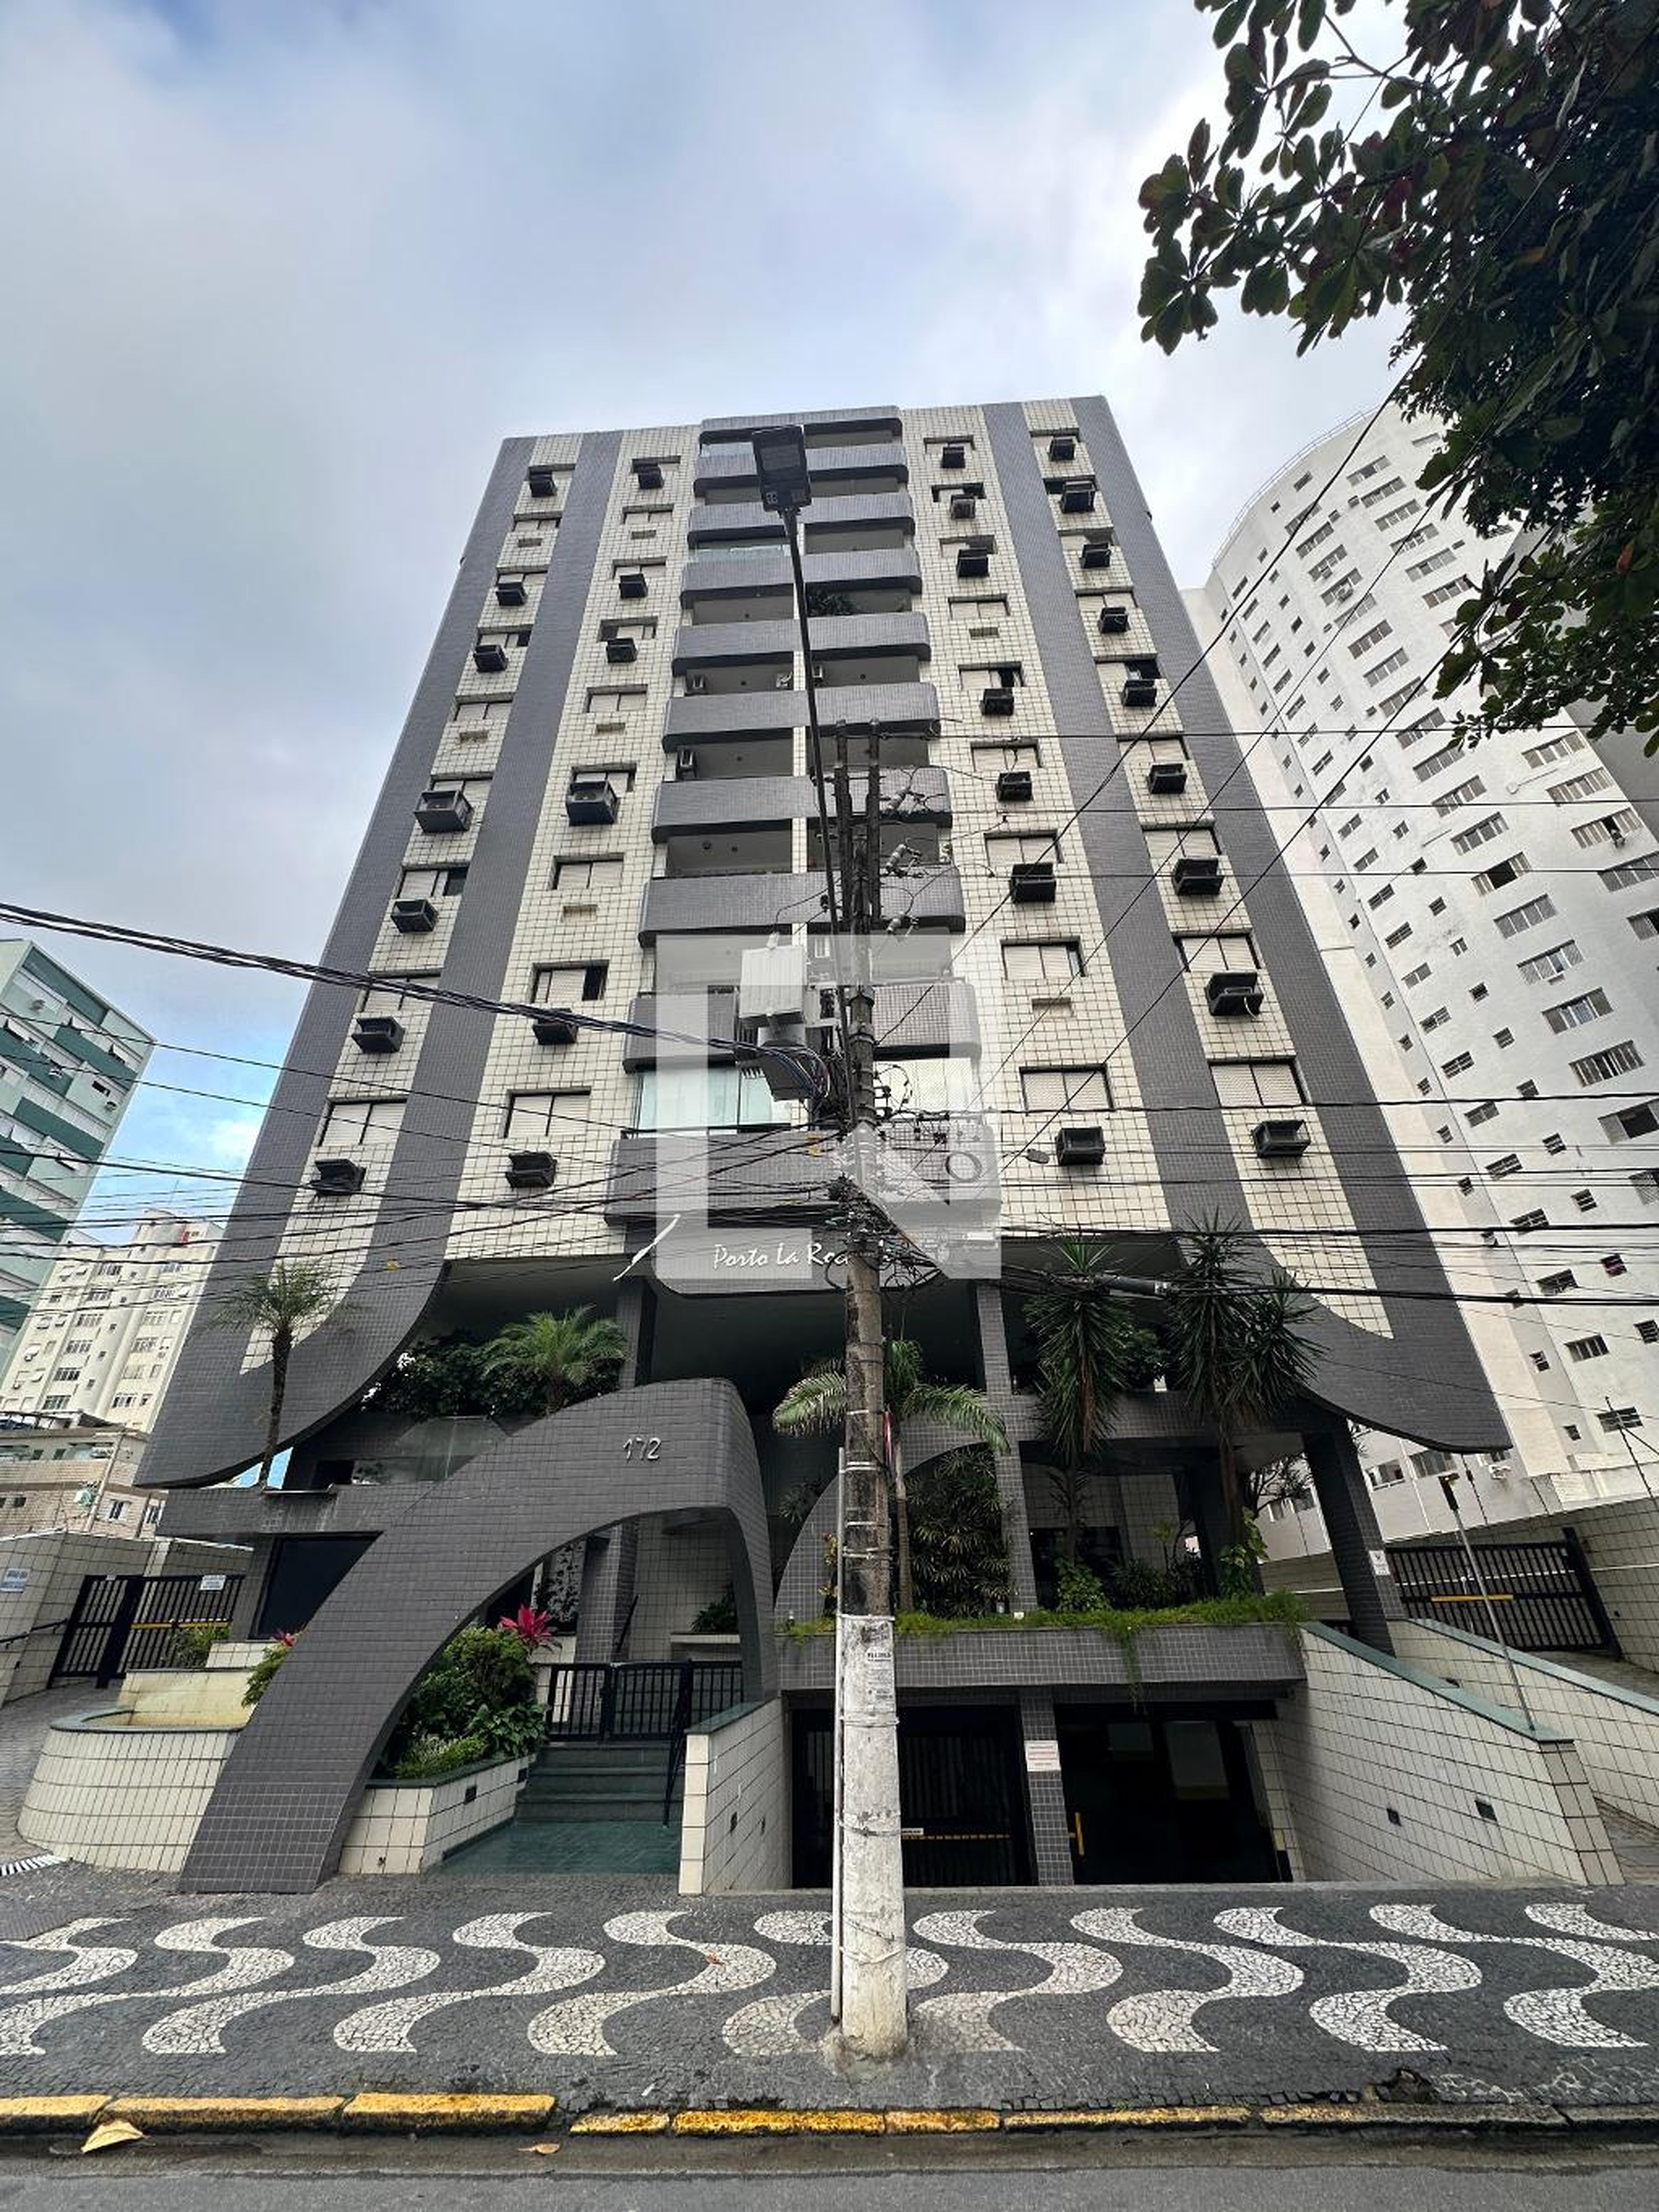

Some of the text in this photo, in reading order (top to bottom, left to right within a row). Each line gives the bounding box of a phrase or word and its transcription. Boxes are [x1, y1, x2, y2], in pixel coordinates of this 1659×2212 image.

[713, 1244, 768, 1270] Porto
[777, 1243, 799, 1265] La
[623, 1437, 661, 1461] 172
